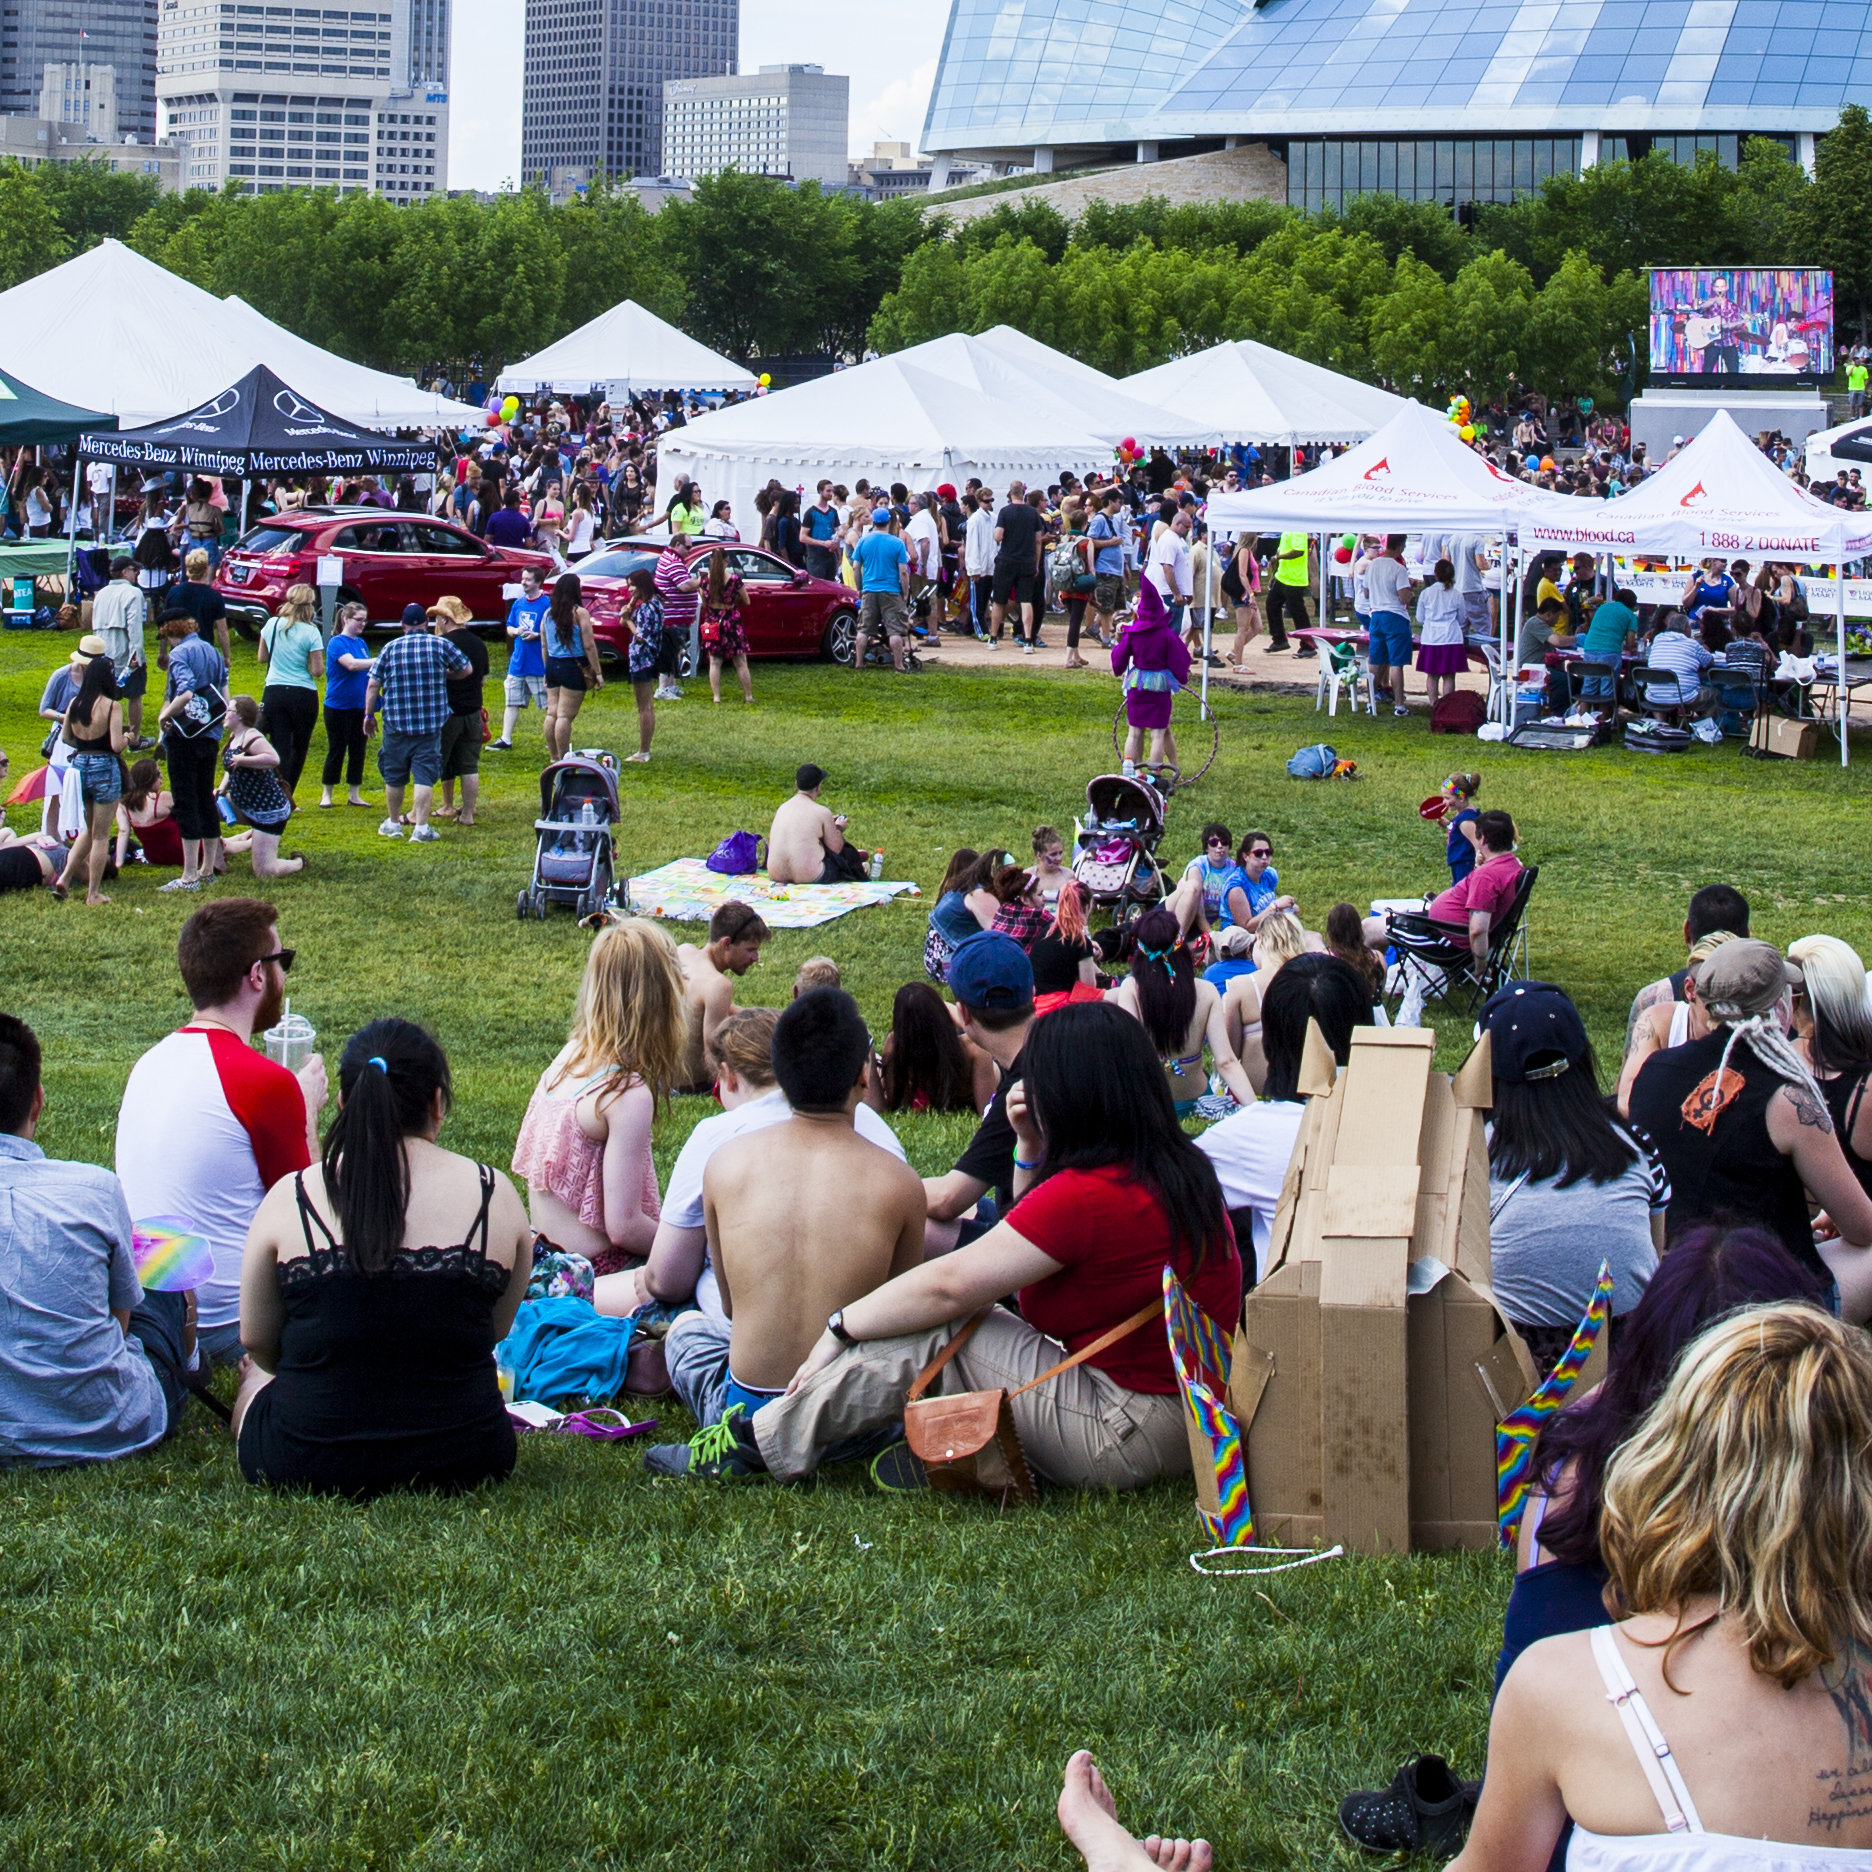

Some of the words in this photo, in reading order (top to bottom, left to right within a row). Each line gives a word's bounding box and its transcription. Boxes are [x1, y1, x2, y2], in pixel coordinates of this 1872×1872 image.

[425, 93, 448, 103] MTS
[79, 433, 177, 463] Mercedes-Benz
[180, 446, 245, 475] Winnipeg
[249, 452, 363, 471] Mercedes-Benz
[366, 448, 436, 470] Winnipeg
[1283, 486, 1348, 498] Canadian
[1353, 483, 1395, 495] Blood
[1400, 487, 1459, 501] Services
[1596, 511, 1665, 520] Canadian
[1671, 508, 1715, 518] Blood
[1720, 508, 1781, 517] Services
[1533, 526, 1636, 544] www.blood.ca
[1700, 531, 1706, 547] 1
[1711, 533, 1740, 550] 888
[1745, 535, 1754, 550] 2
[1758, 537, 1820, 553] DONATE
